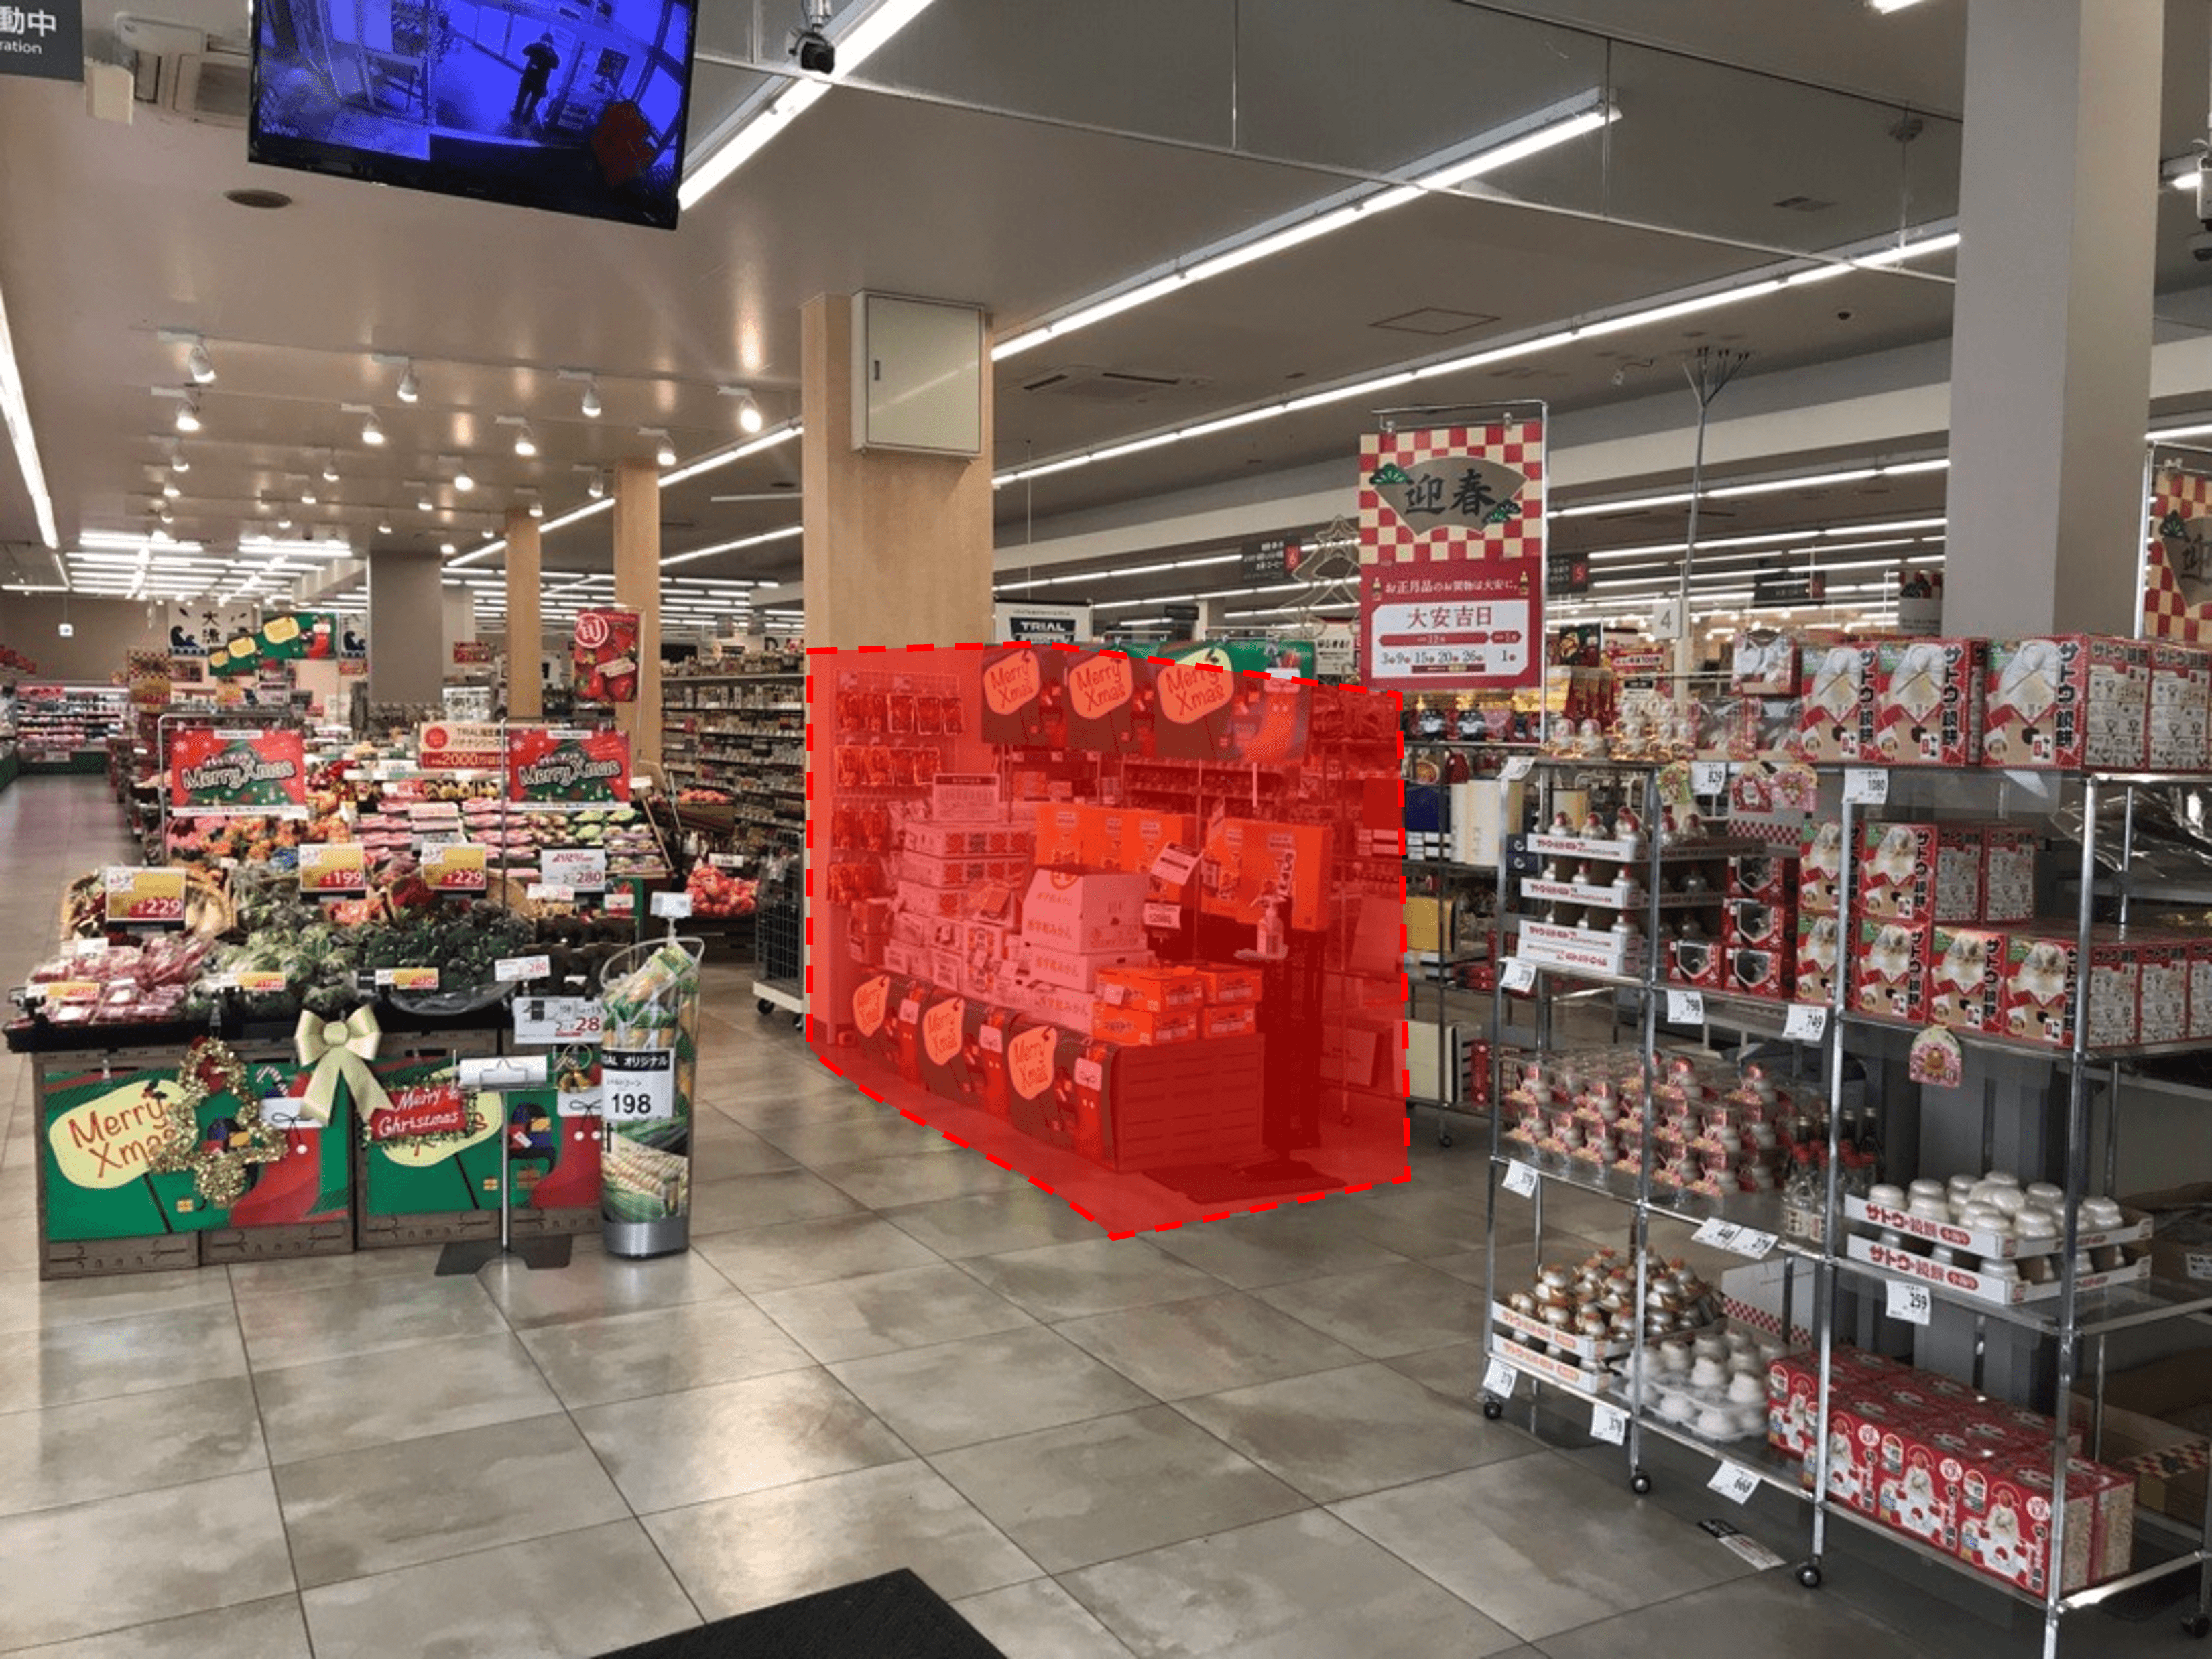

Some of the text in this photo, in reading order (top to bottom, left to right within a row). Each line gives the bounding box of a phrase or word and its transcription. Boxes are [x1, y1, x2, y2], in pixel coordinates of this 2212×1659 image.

[1405, 468, 1497, 517] 迎春
[1020, 621, 1066, 631] TRIAL
[1407, 605, 1493, 629] 大安吉日
[1660, 609, 1672, 631] 4
[146, 898, 182, 914] 229
[623, 1055, 670, 1067] オリジナル
[611, 1093, 652, 1115] 198
[68, 1099, 168, 1149] Merry
[377, 1111, 459, 1137] Christmas
